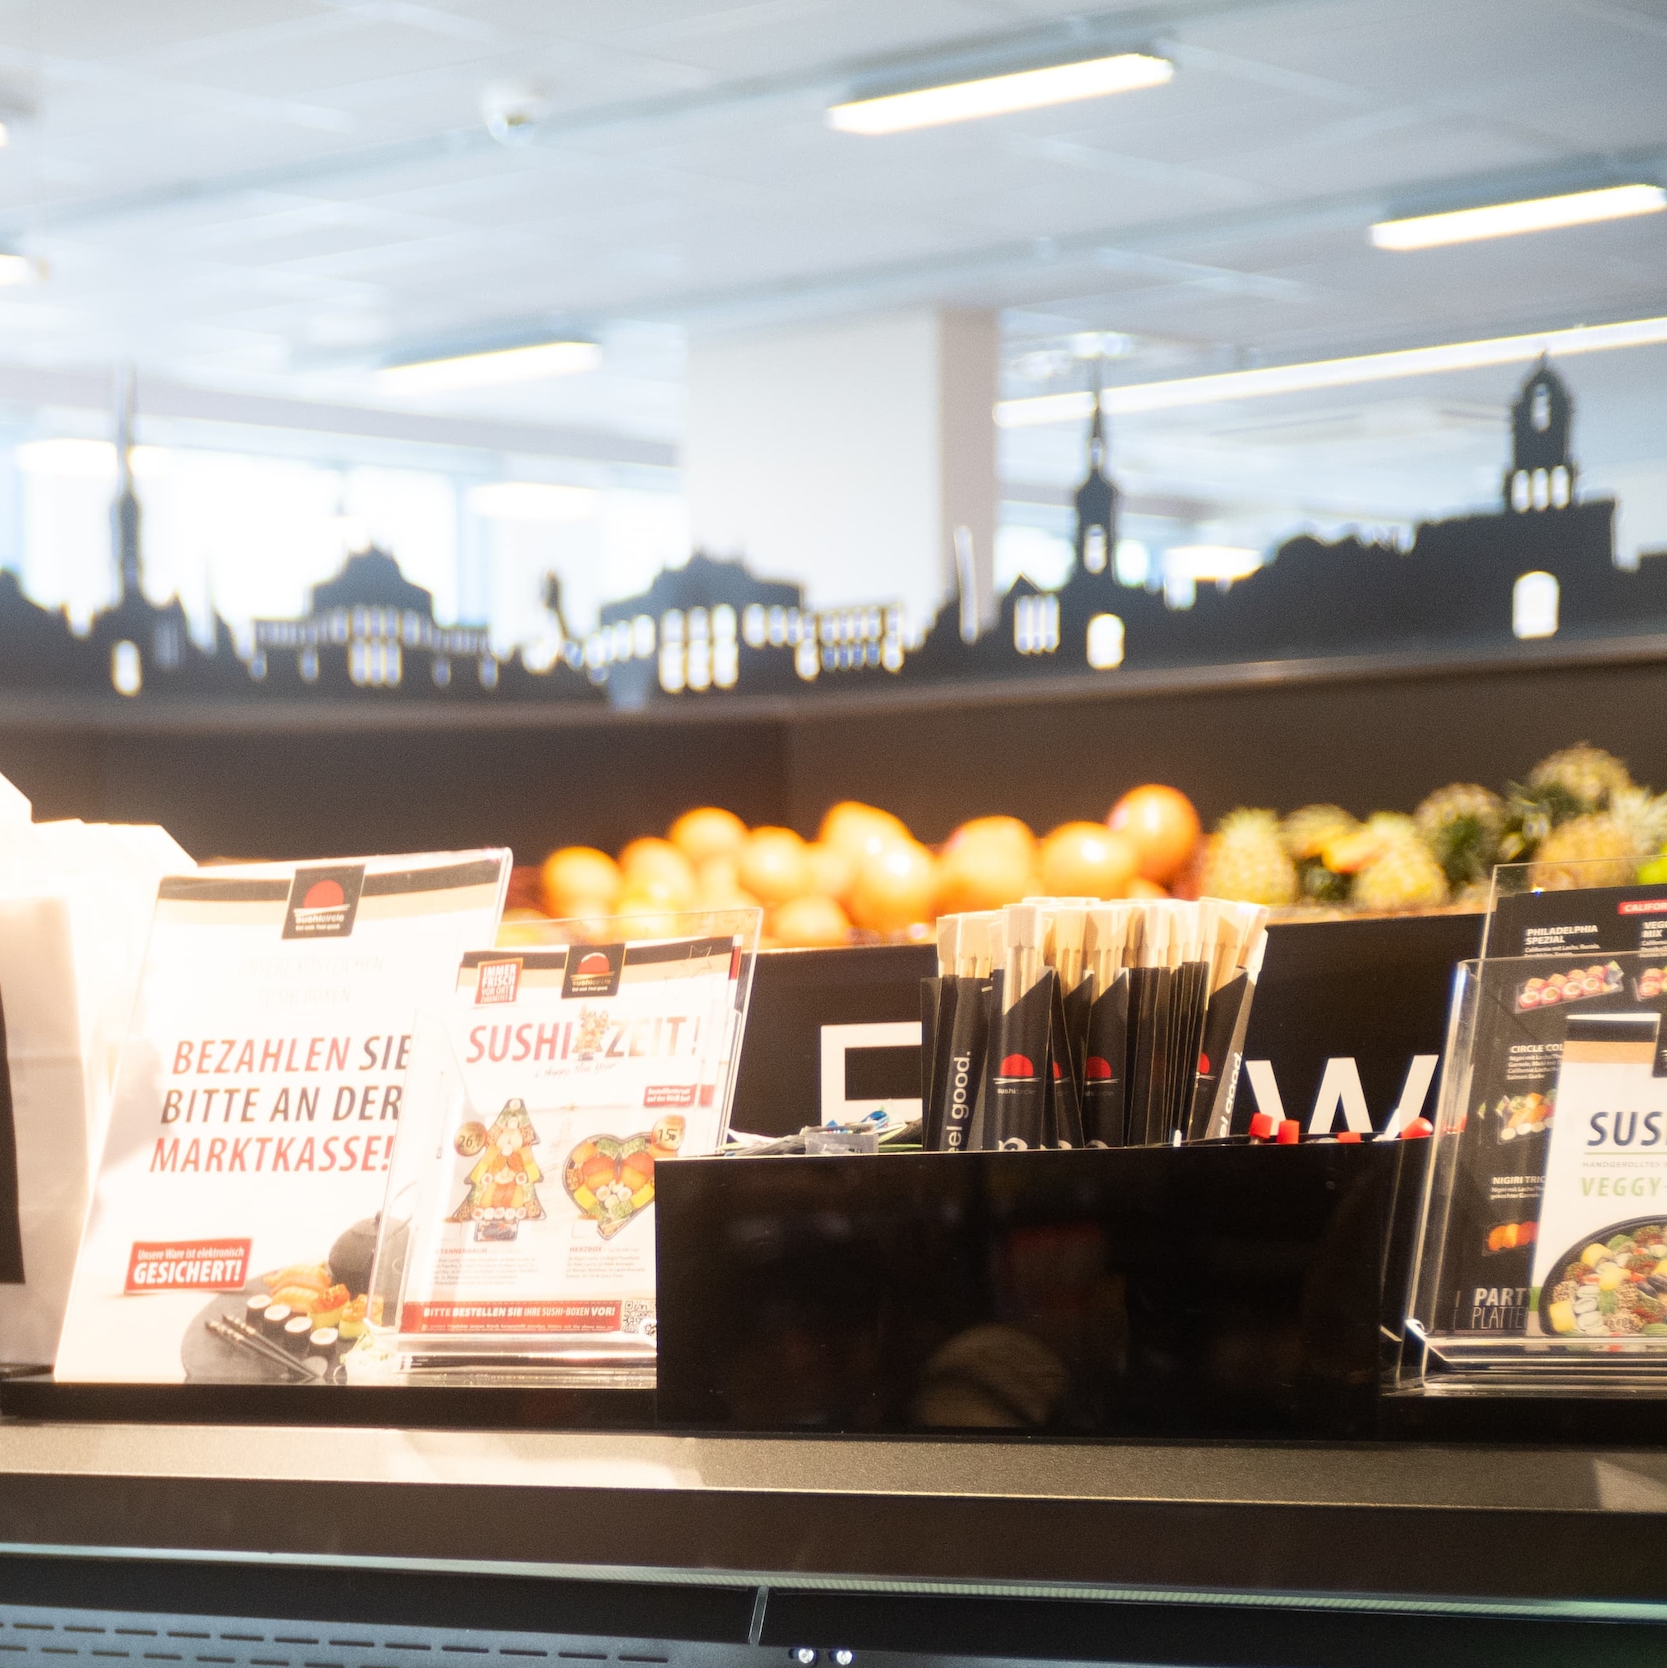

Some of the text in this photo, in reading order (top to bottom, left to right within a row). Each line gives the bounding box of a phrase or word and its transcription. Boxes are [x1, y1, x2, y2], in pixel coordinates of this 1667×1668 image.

[1527, 925, 1599, 937] PHILADELPHIA
[1526, 936, 1566, 945] SPEZIAL
[483, 963, 516, 977] IMMER
[482, 975, 516, 987] FRISCH
[466, 1021, 573, 1063] SUSHI
[1511, 1045, 1544, 1053] CIRCLE
[172, 1035, 413, 1075] BEZAHLEN SIE
[161, 1084, 403, 1124] BITTE AN DER
[1587, 1111, 1667, 1146] SUS
[150, 1134, 394, 1173] MARKTKASSE!
[1493, 1176, 1524, 1184] NIGIRI
[1581, 1176, 1662, 1197] VEGGY
[138, 1246, 245, 1260] Unsere Ware ist elektronisch
[133, 1259, 243, 1284] GESICHERT!
[424, 1306, 615, 1317] BITTE BESTELLEN SIE IHRE SUSHI-BOXEN VOR!
